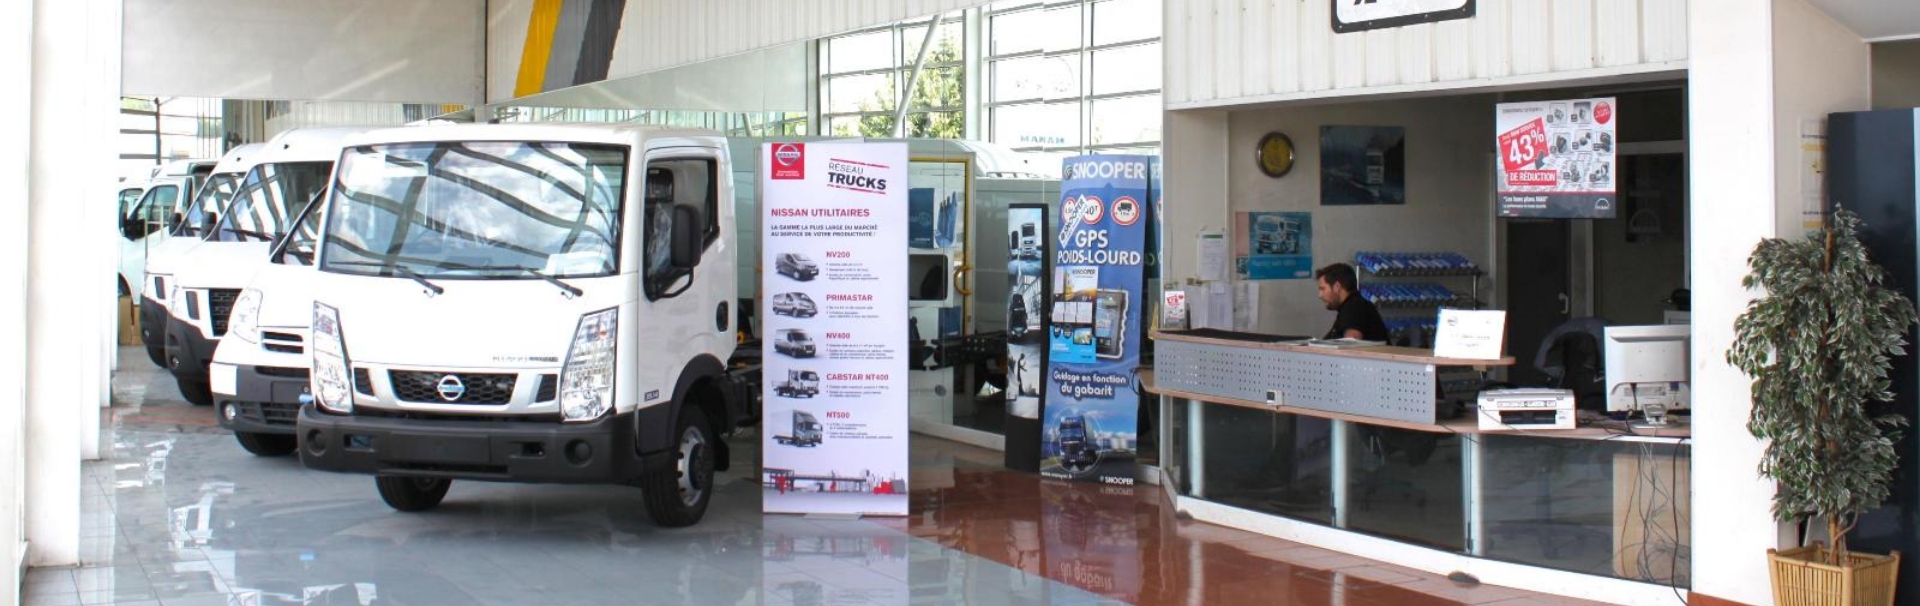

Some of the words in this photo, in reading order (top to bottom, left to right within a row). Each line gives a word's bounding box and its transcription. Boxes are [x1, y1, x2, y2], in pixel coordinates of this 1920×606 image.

[1072, 161, 1145, 180] SNOOPER
[1510, 173, 1519, 181] DE
[1520, 171, 1556, 181] RÉDUCTION
[828, 172, 887, 190] TRUCKS
[771, 208, 808, 217] NISSAN
[811, 208, 870, 217] UTILITAIRES
[1075, 229, 1108, 248] GPS
[1057, 249, 1141, 265] POIDS-LOURD
[826, 294, 873, 302] PRIMASTAR
[1053, 371, 1080, 382] Guidage
[1092, 374, 1127, 384] fonction
[1061, 384, 1072, 393] du
[1074, 384, 1112, 397] gabarit
[1105, 476, 1134, 485] SNOOPER
